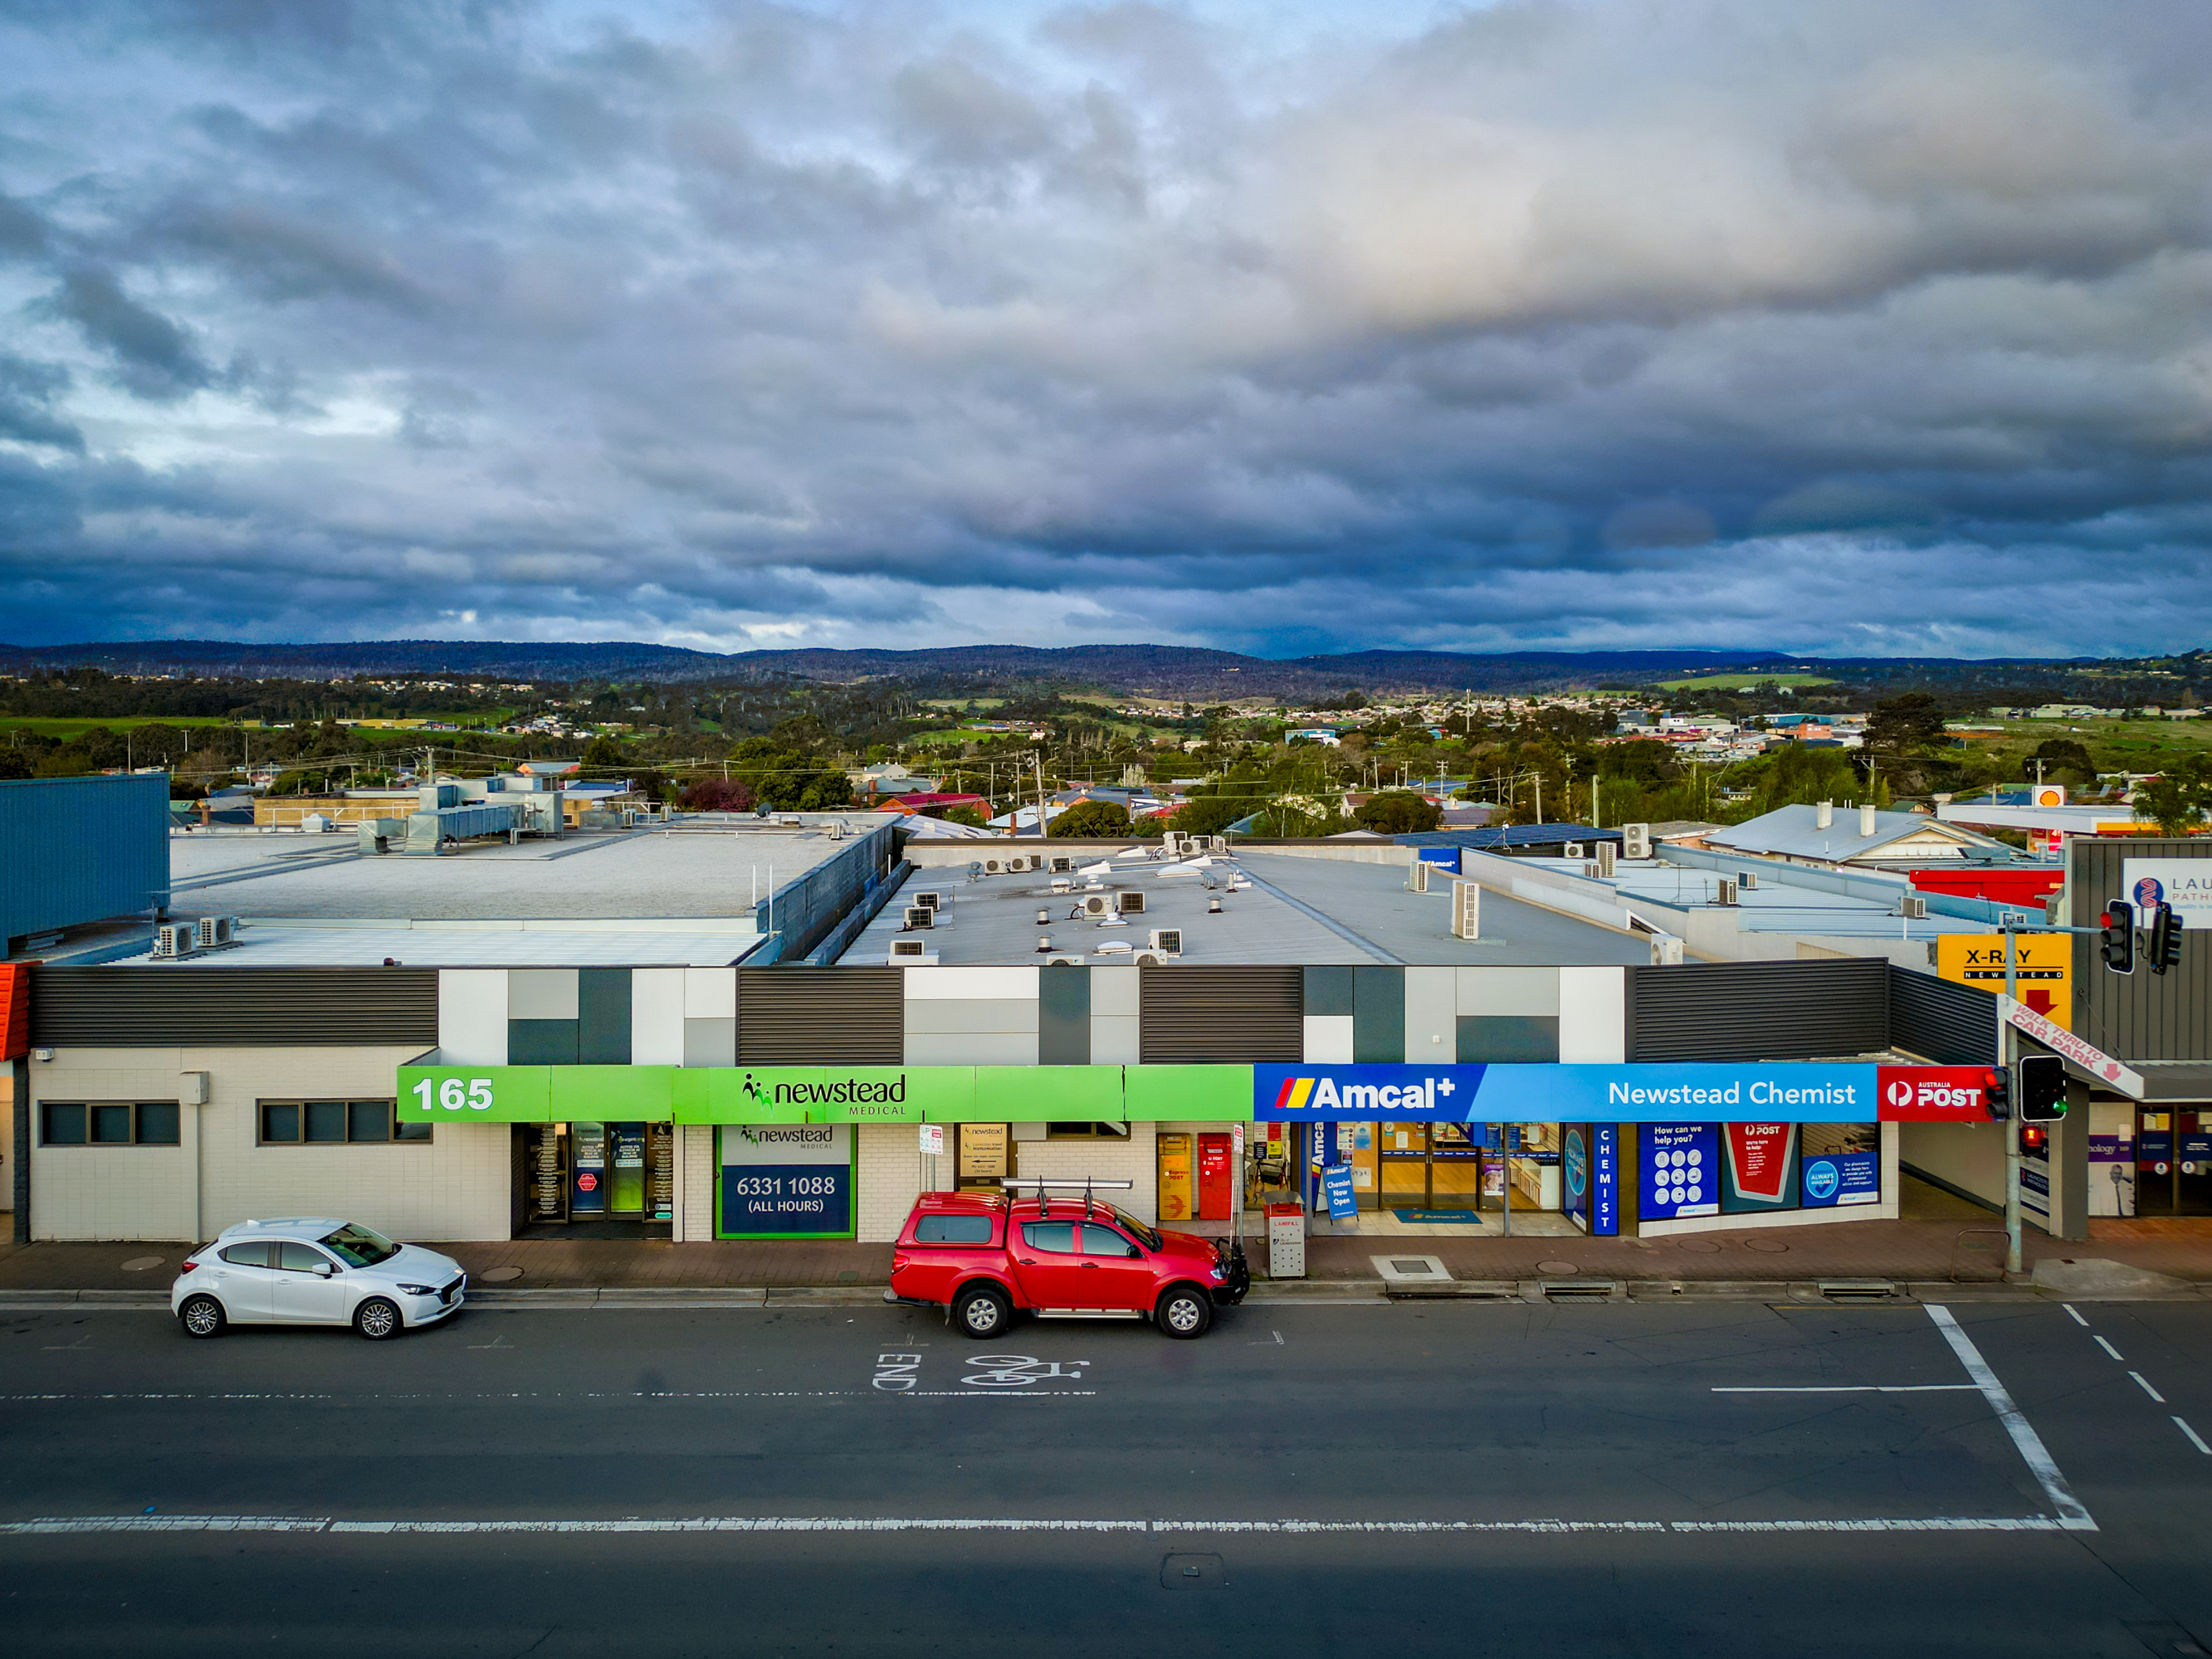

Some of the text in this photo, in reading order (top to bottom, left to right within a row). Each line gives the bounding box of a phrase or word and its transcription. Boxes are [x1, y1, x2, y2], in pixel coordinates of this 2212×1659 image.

[2012, 1014, 2097, 1070] CAR PARK
[2015, 1005, 2104, 1061] WALK THRU TO
[413, 1078, 494, 1110] 165
[775, 1074, 906, 1104] newstead
[1609, 1081, 1856, 1105] Newstead Chemist
[1917, 1088, 1981, 1107] POST
[849, 1106, 906, 1115] MEDICAL
[759, 1125, 833, 1143] newstead
[1654, 1134, 1693, 1145] help you?
[1756, 1126, 1780, 1135] POST
[737, 1177, 835, 1195] 6331 1088
[1327, 1180, 1351, 1189] Chemist
[1599, 1130, 1611, 1227] CHEMIST
[748, 1199, 824, 1213] (ALL HOURS)
[872, 1354, 921, 1390] END
